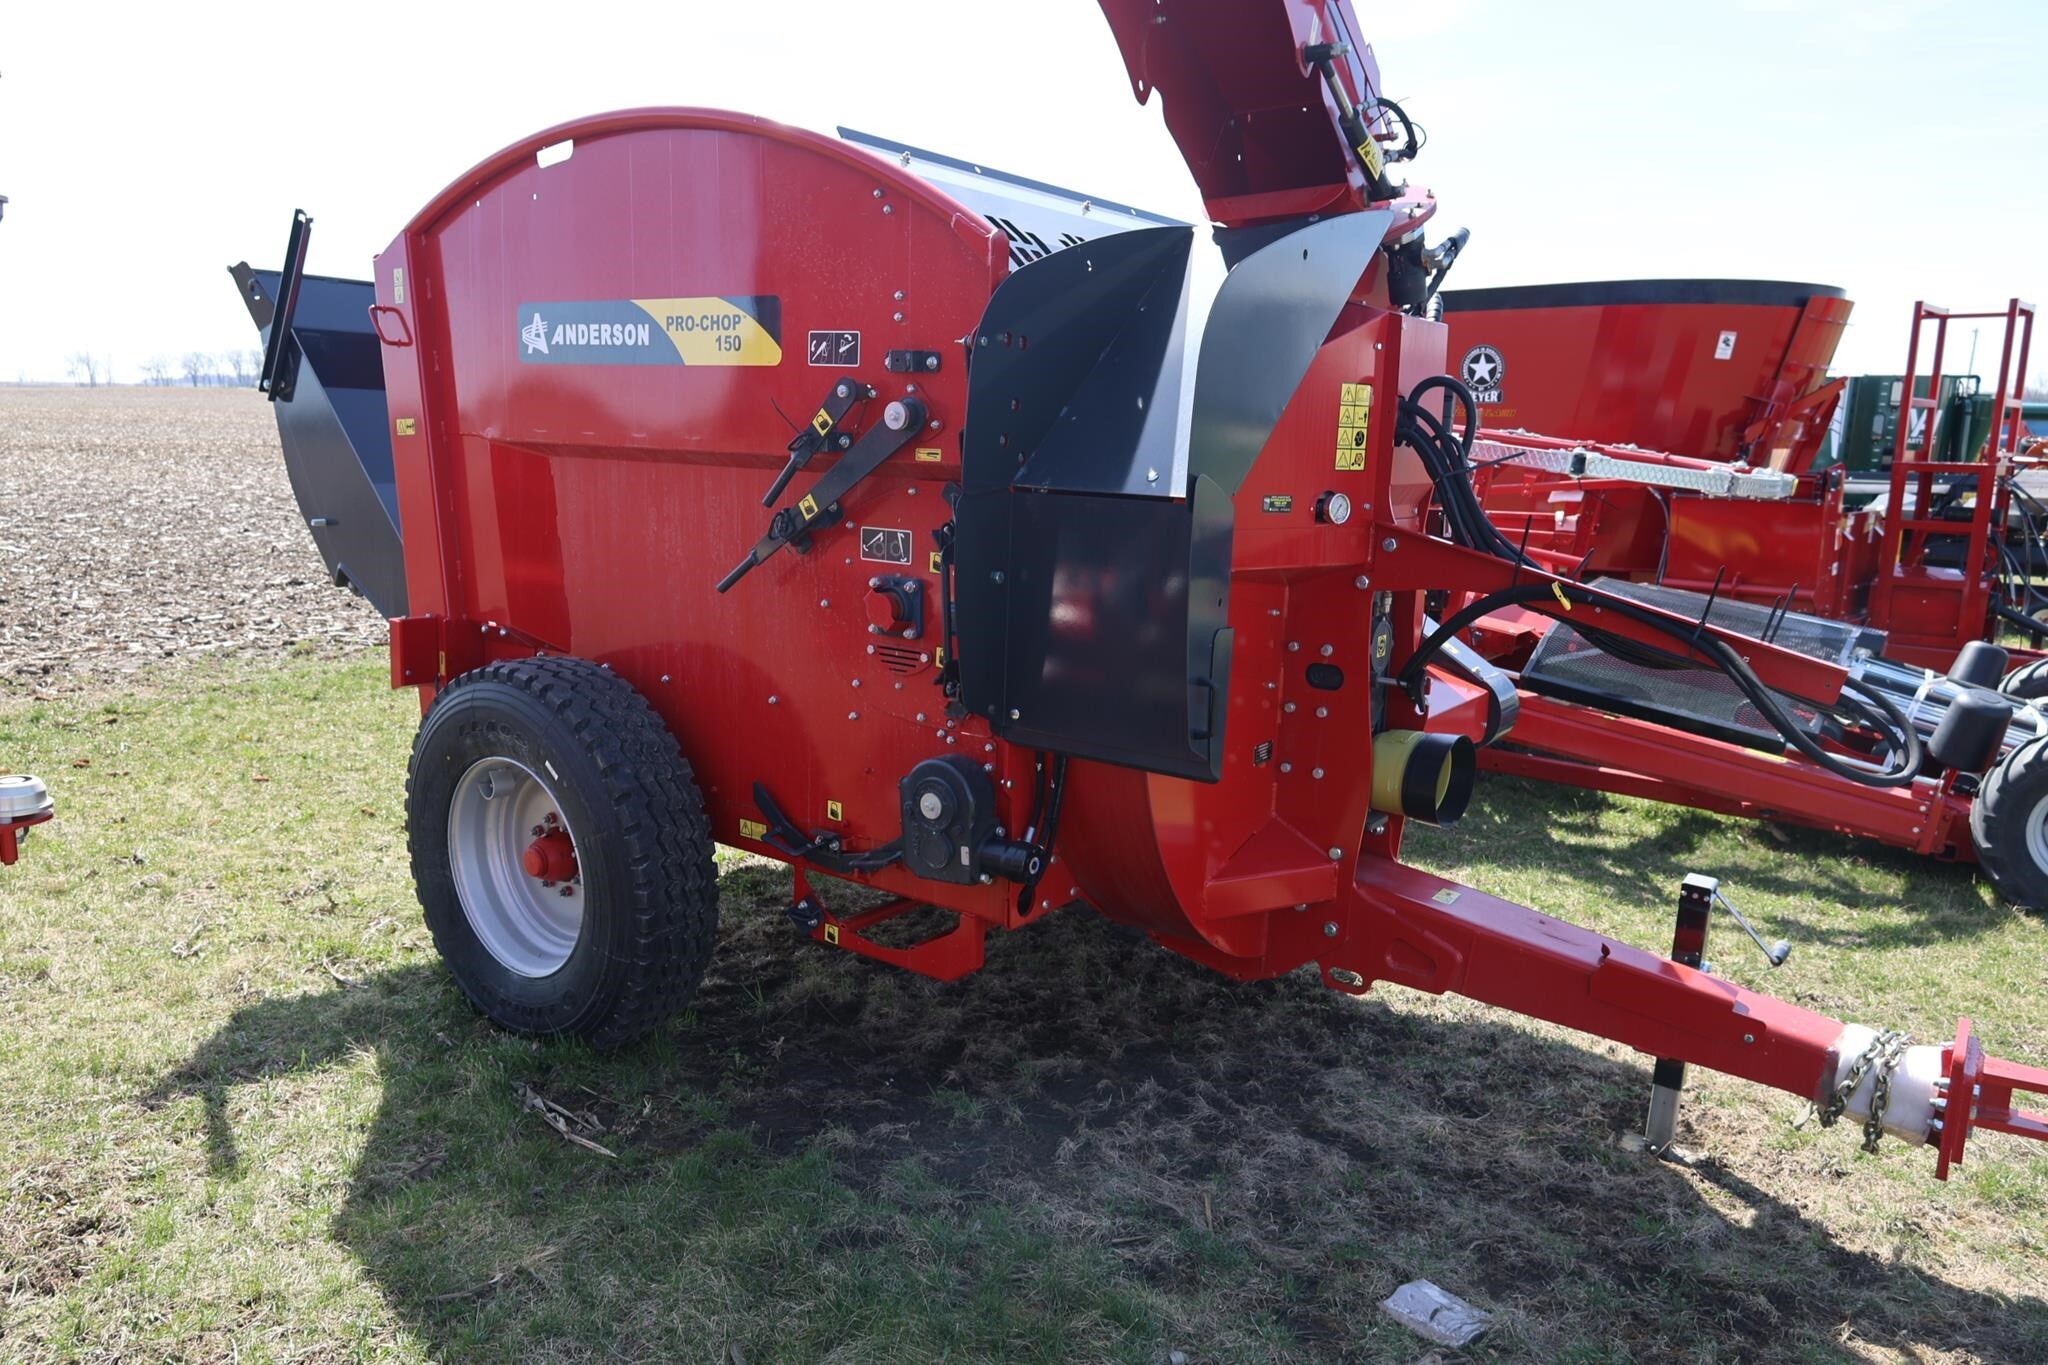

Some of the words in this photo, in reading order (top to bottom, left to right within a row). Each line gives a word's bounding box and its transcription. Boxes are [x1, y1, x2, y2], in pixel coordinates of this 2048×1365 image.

[551, 324, 649, 346] ANDERSON
[715, 335, 741, 352] 150
[1469, 390, 1498, 402] EYER
